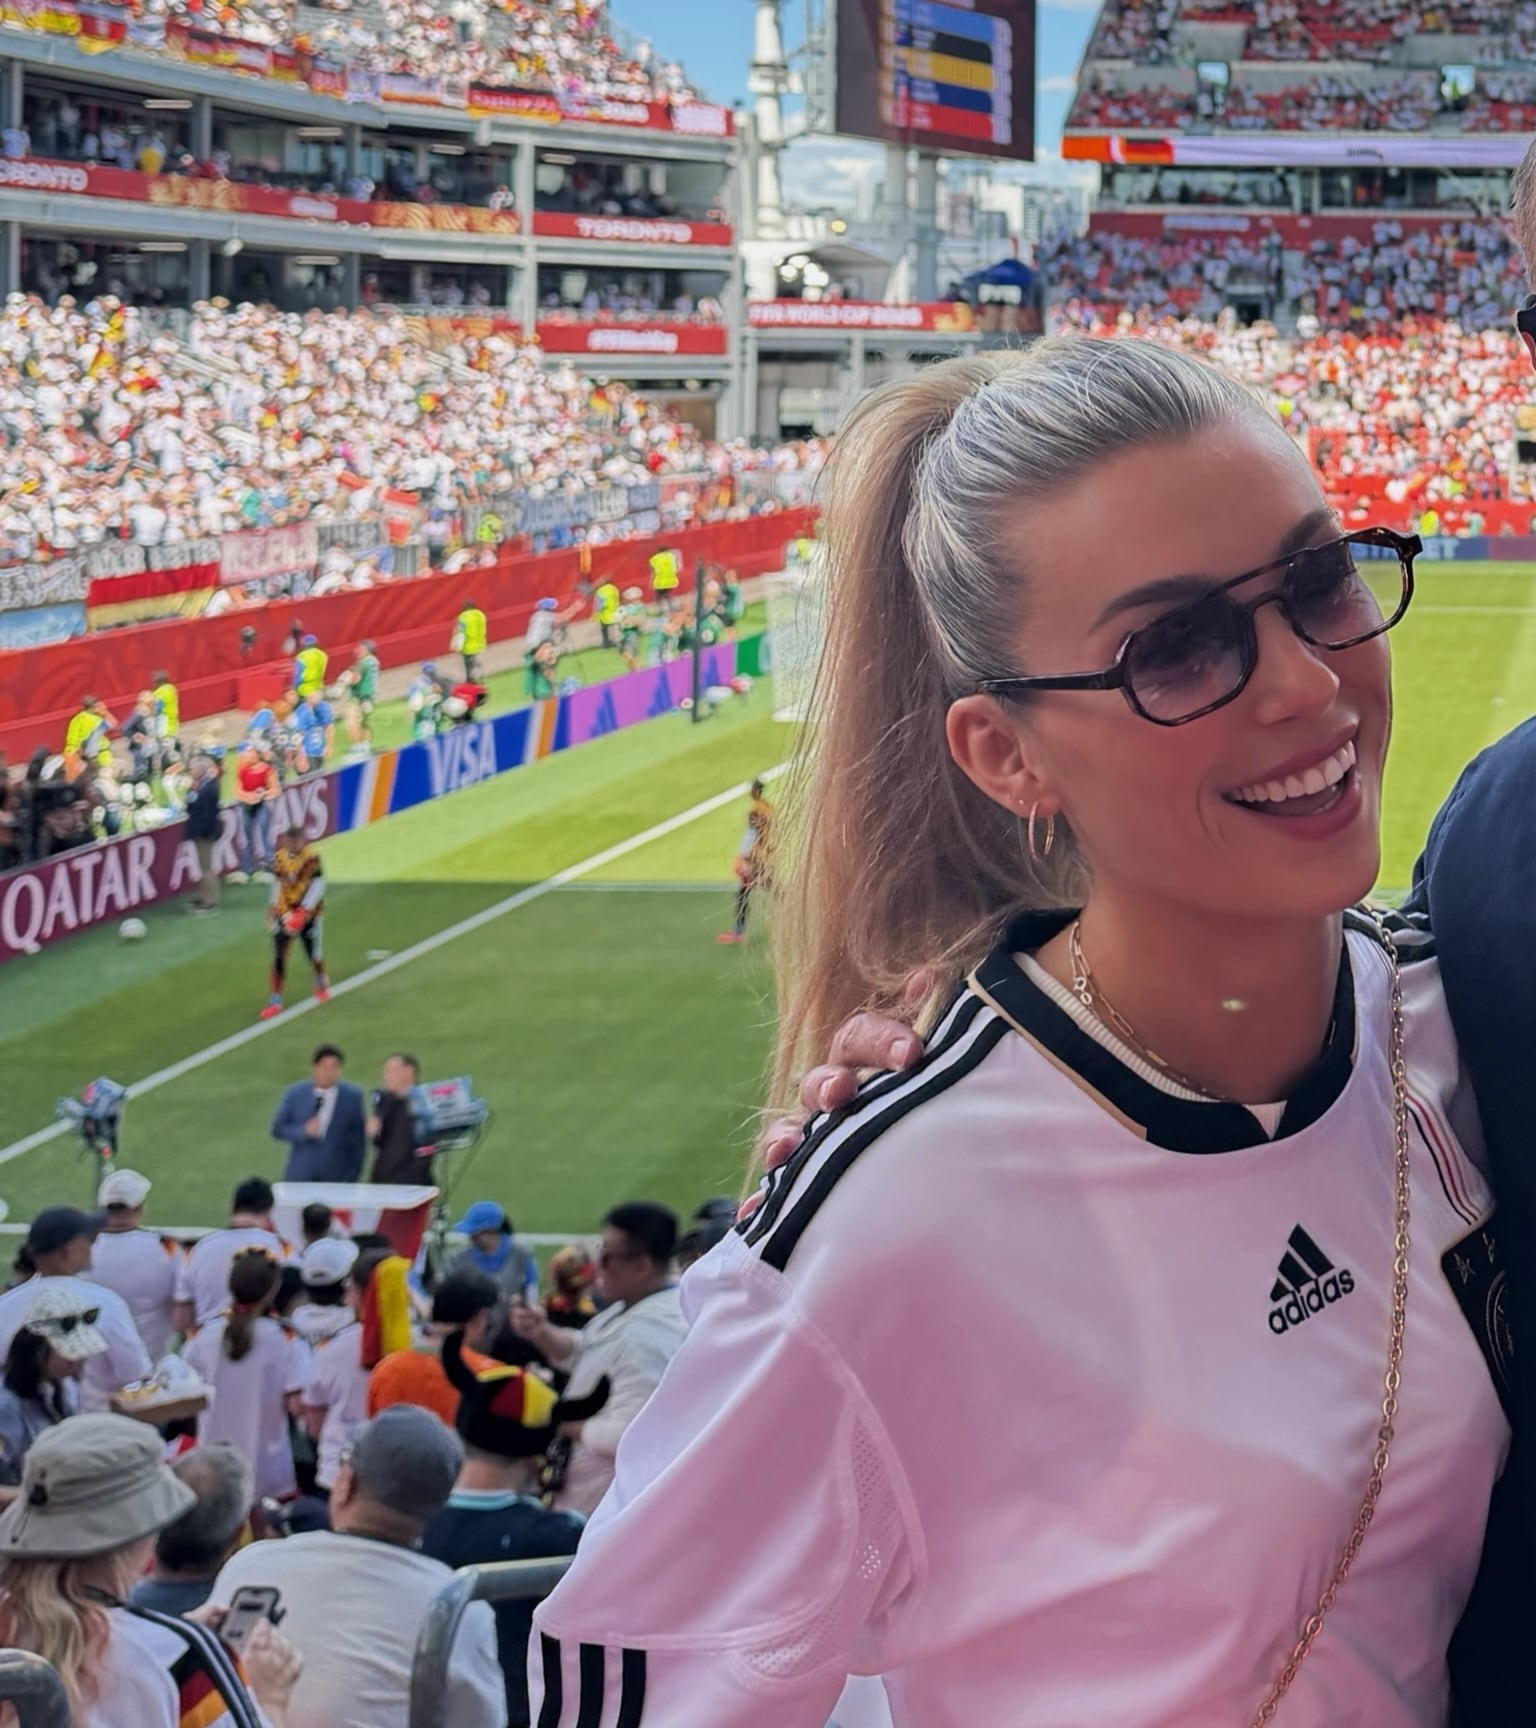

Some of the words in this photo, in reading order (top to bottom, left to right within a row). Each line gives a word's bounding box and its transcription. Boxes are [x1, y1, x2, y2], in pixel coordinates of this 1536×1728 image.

[574, 218, 692, 242] TORONTO
[787, 304, 840, 324] WORLD
[427, 722, 498, 794] VISA
[1, 835, 157, 954] QATAR
[1268, 1268, 1355, 1335] adidas
